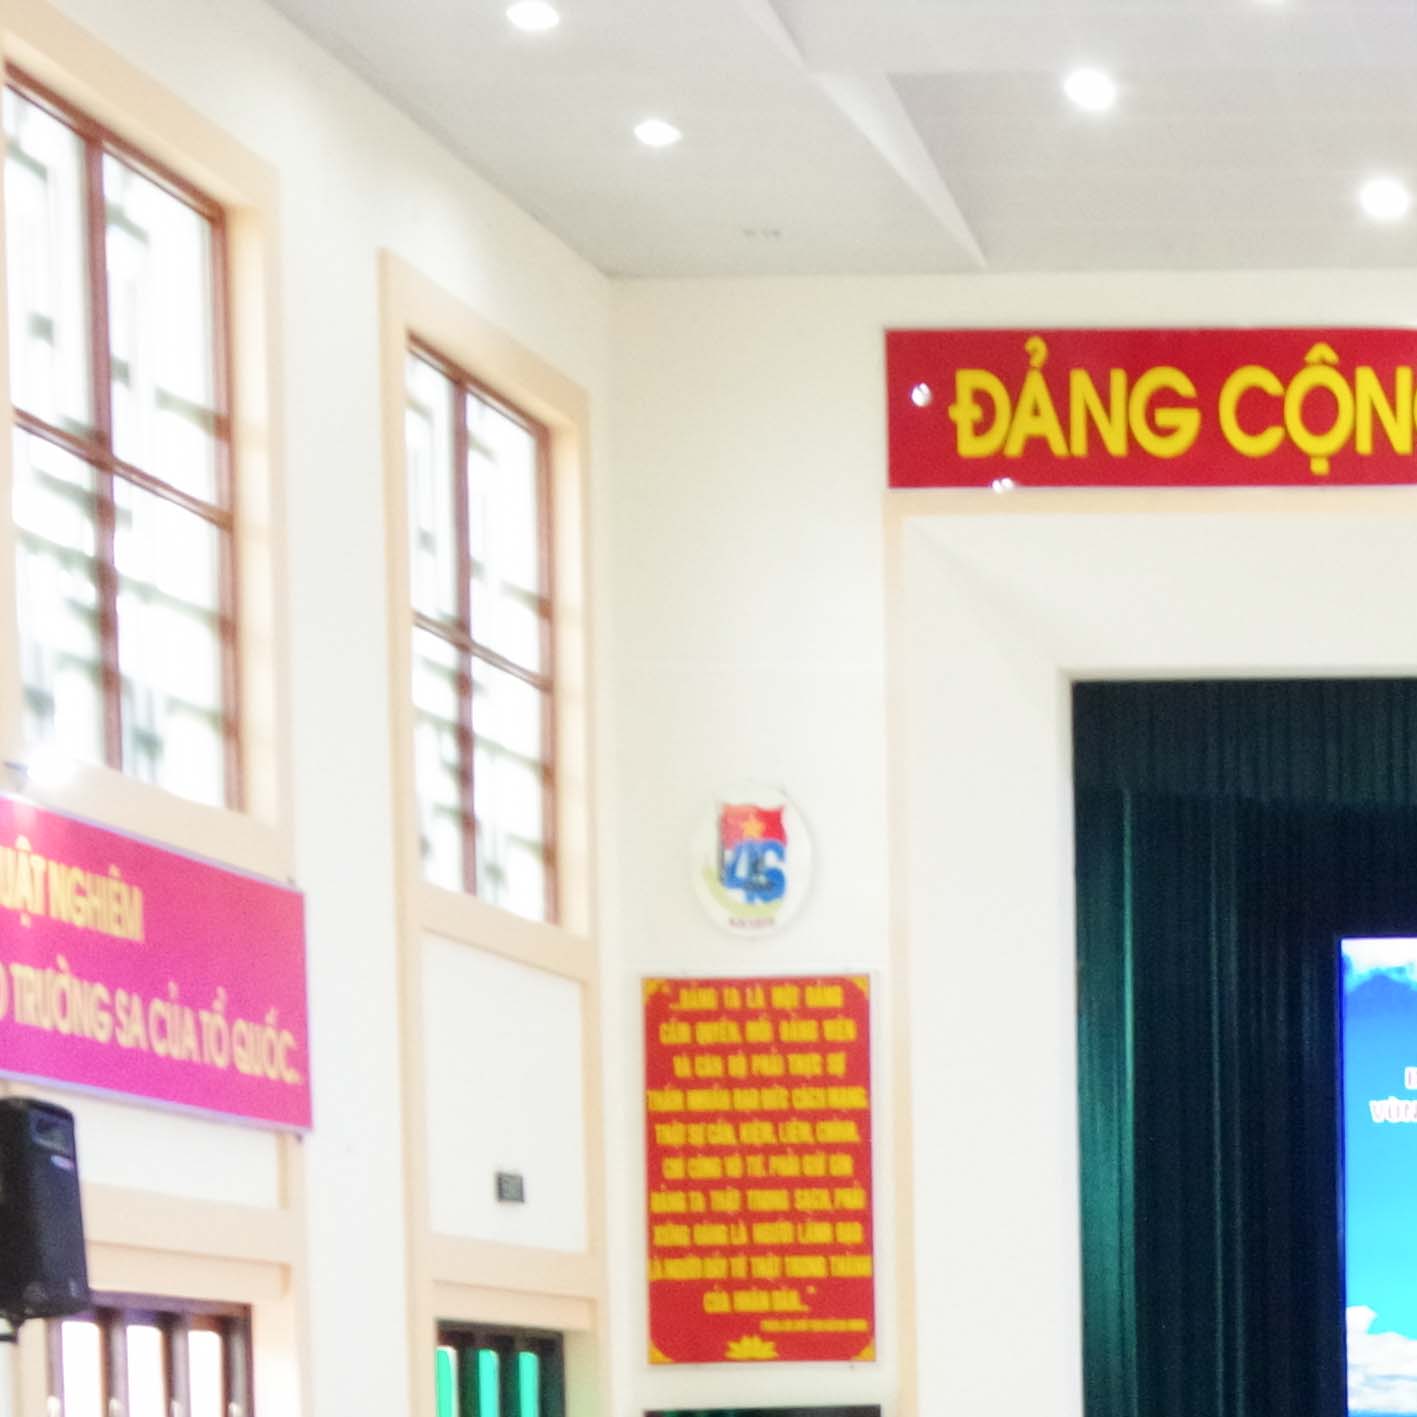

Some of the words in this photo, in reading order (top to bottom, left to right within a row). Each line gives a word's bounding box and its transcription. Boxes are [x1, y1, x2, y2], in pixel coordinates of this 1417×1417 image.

[948, 336, 1200, 458] ĐẢNG
[10, 953, 113, 1045] TRƯỜNG
[114, 986, 150, 1051] SA
[149, 979, 200, 1064] CỦA
[198, 985, 233, 1070] TỔ
